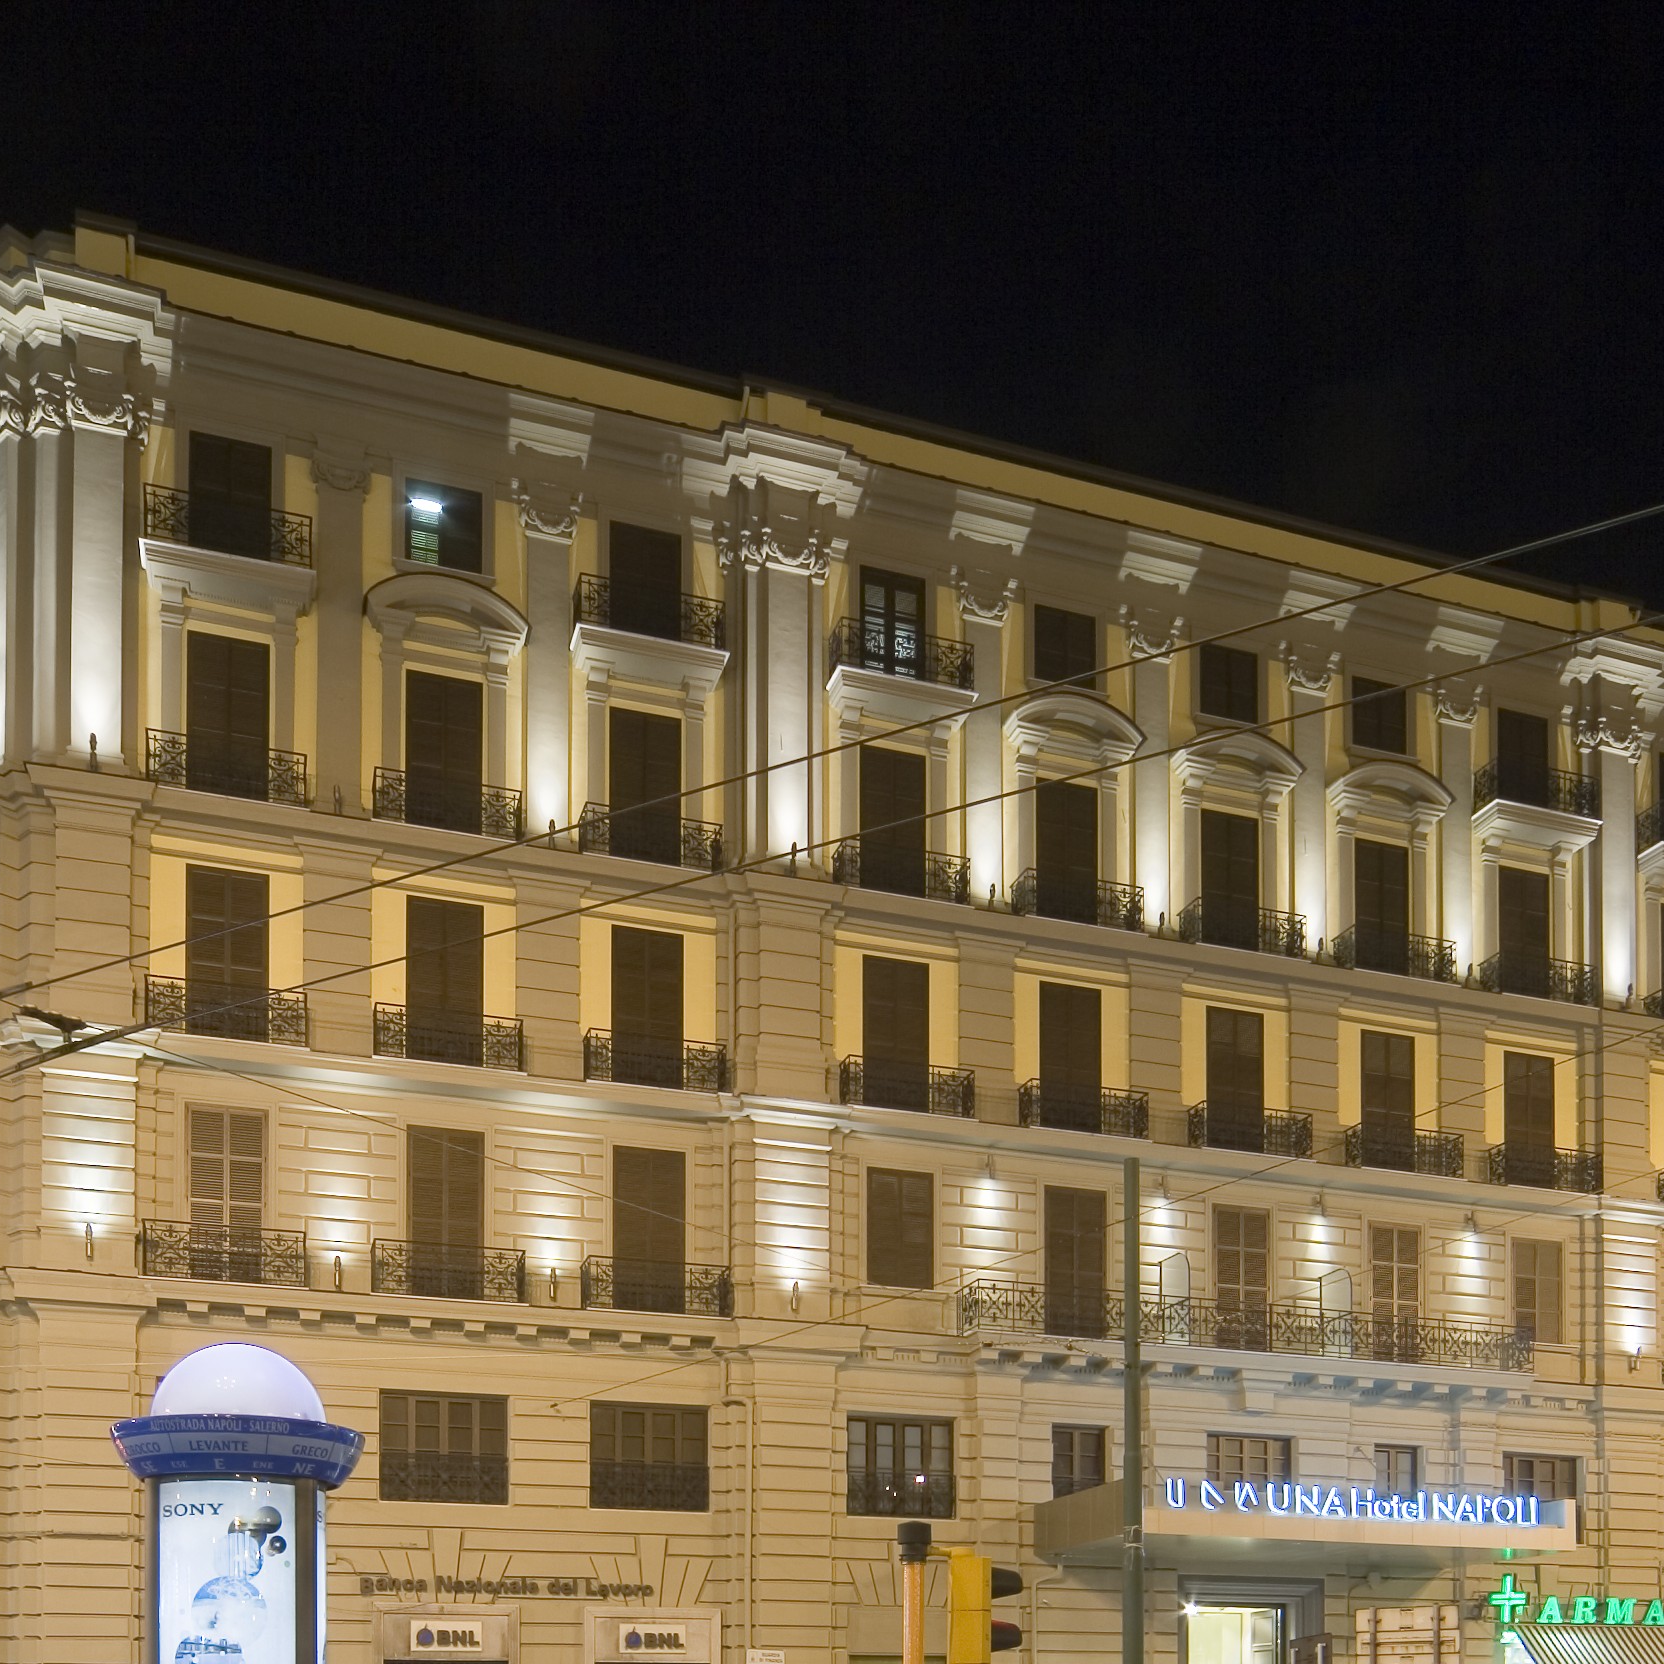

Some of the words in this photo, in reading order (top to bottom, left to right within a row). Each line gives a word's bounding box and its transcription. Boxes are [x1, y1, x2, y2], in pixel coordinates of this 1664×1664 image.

[150, 1417, 206, 1432] AUTOSTRADA
[207, 1418, 242, 1431] NAPOLI
[249, 1420, 290, 1434] SALERNO
[188, 1440, 249, 1452] LEVANTE
[292, 1444, 329, 1459] GRECO
[291, 1462, 316, 1475] NE
[162, 1503, 224, 1518] SONY
[1266, 1482, 1347, 1519] UNA
[1350, 1486, 1427, 1523] Hotel
[1431, 1492, 1540, 1527] NAPOLI
[360, 1575, 428, 1597] Banca
[436, 1575, 540, 1597] Nazionale
[547, 1577, 579, 1596] del
[586, 1578, 655, 1598] Lavoro
[436, 1629, 480, 1647] BNL
[644, 1631, 684, 1649] BNL
